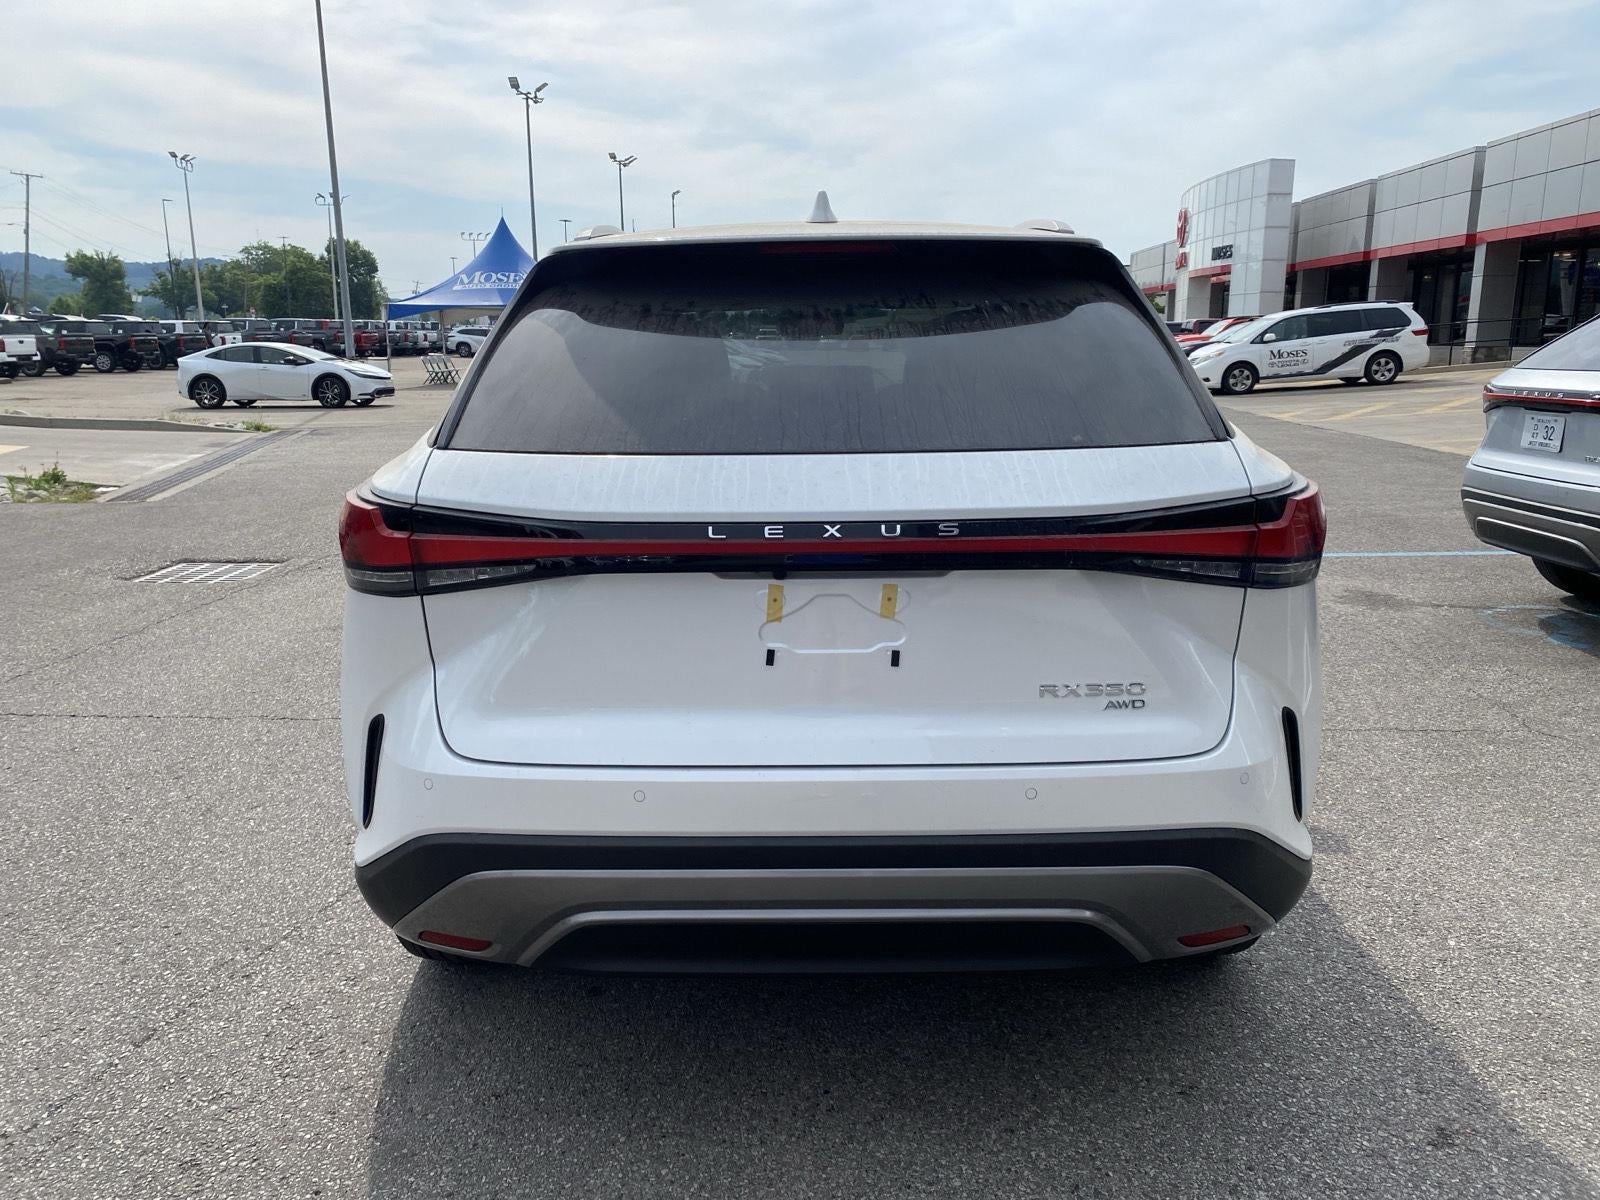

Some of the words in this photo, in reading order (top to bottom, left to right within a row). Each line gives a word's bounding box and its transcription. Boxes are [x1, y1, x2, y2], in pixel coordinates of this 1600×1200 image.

[1269, 348, 1308, 360] MOSES
[1513, 390, 1565, 399] LEXUS
[1542, 425, 1555, 441] 32
[708, 522, 960, 540] LEXUS
[1103, 699, 1146, 711] AWD
